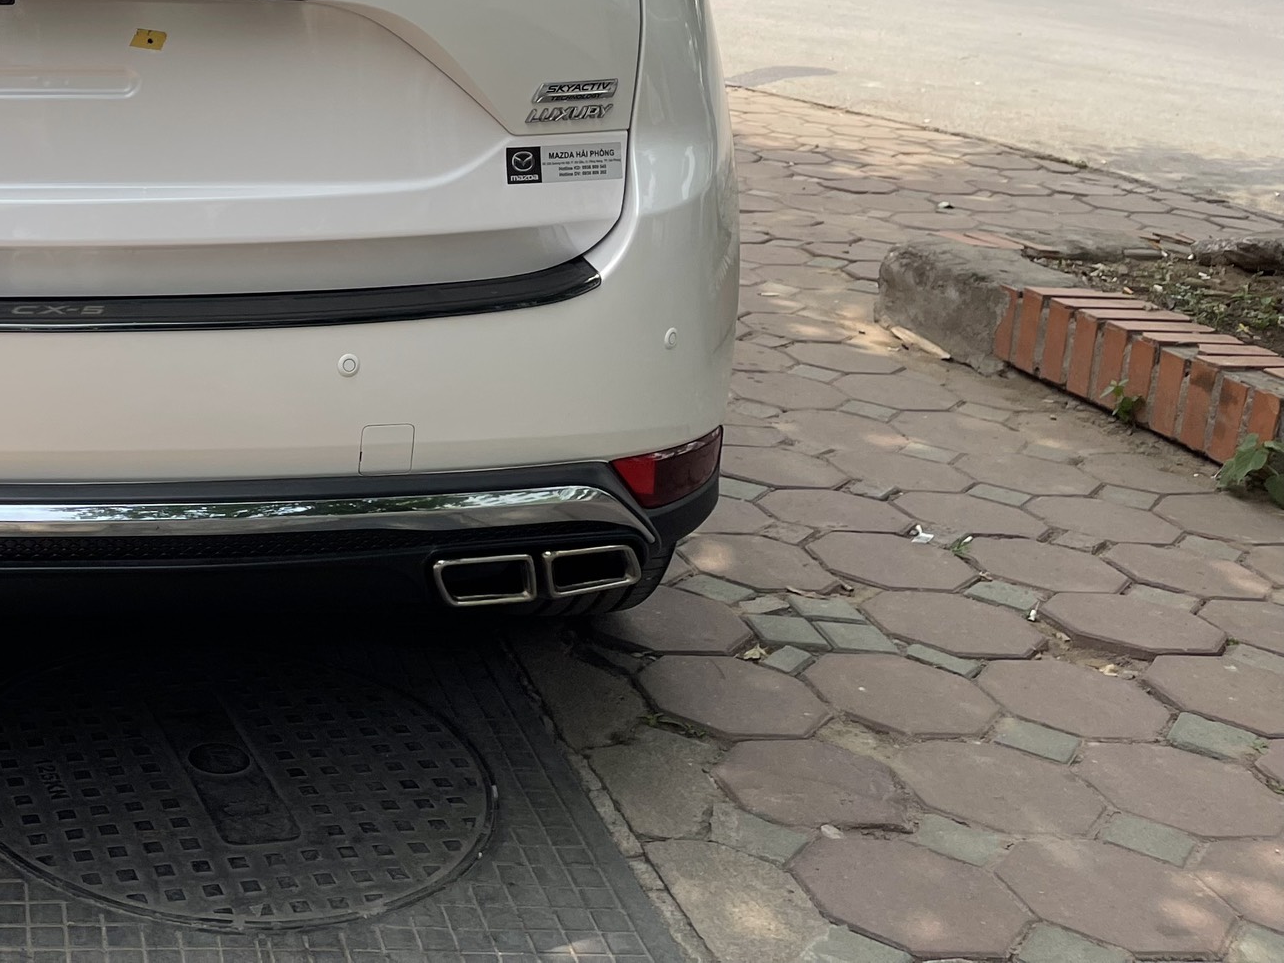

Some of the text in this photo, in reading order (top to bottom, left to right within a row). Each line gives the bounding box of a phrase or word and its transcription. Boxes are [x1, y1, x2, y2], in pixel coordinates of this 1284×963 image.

[546, 82, 612, 93] SKYACTIV
[525, 103, 613, 123] LUXURY
[548, 151, 574, 159] MAZDA
[11, 305, 105, 315] CX-5
